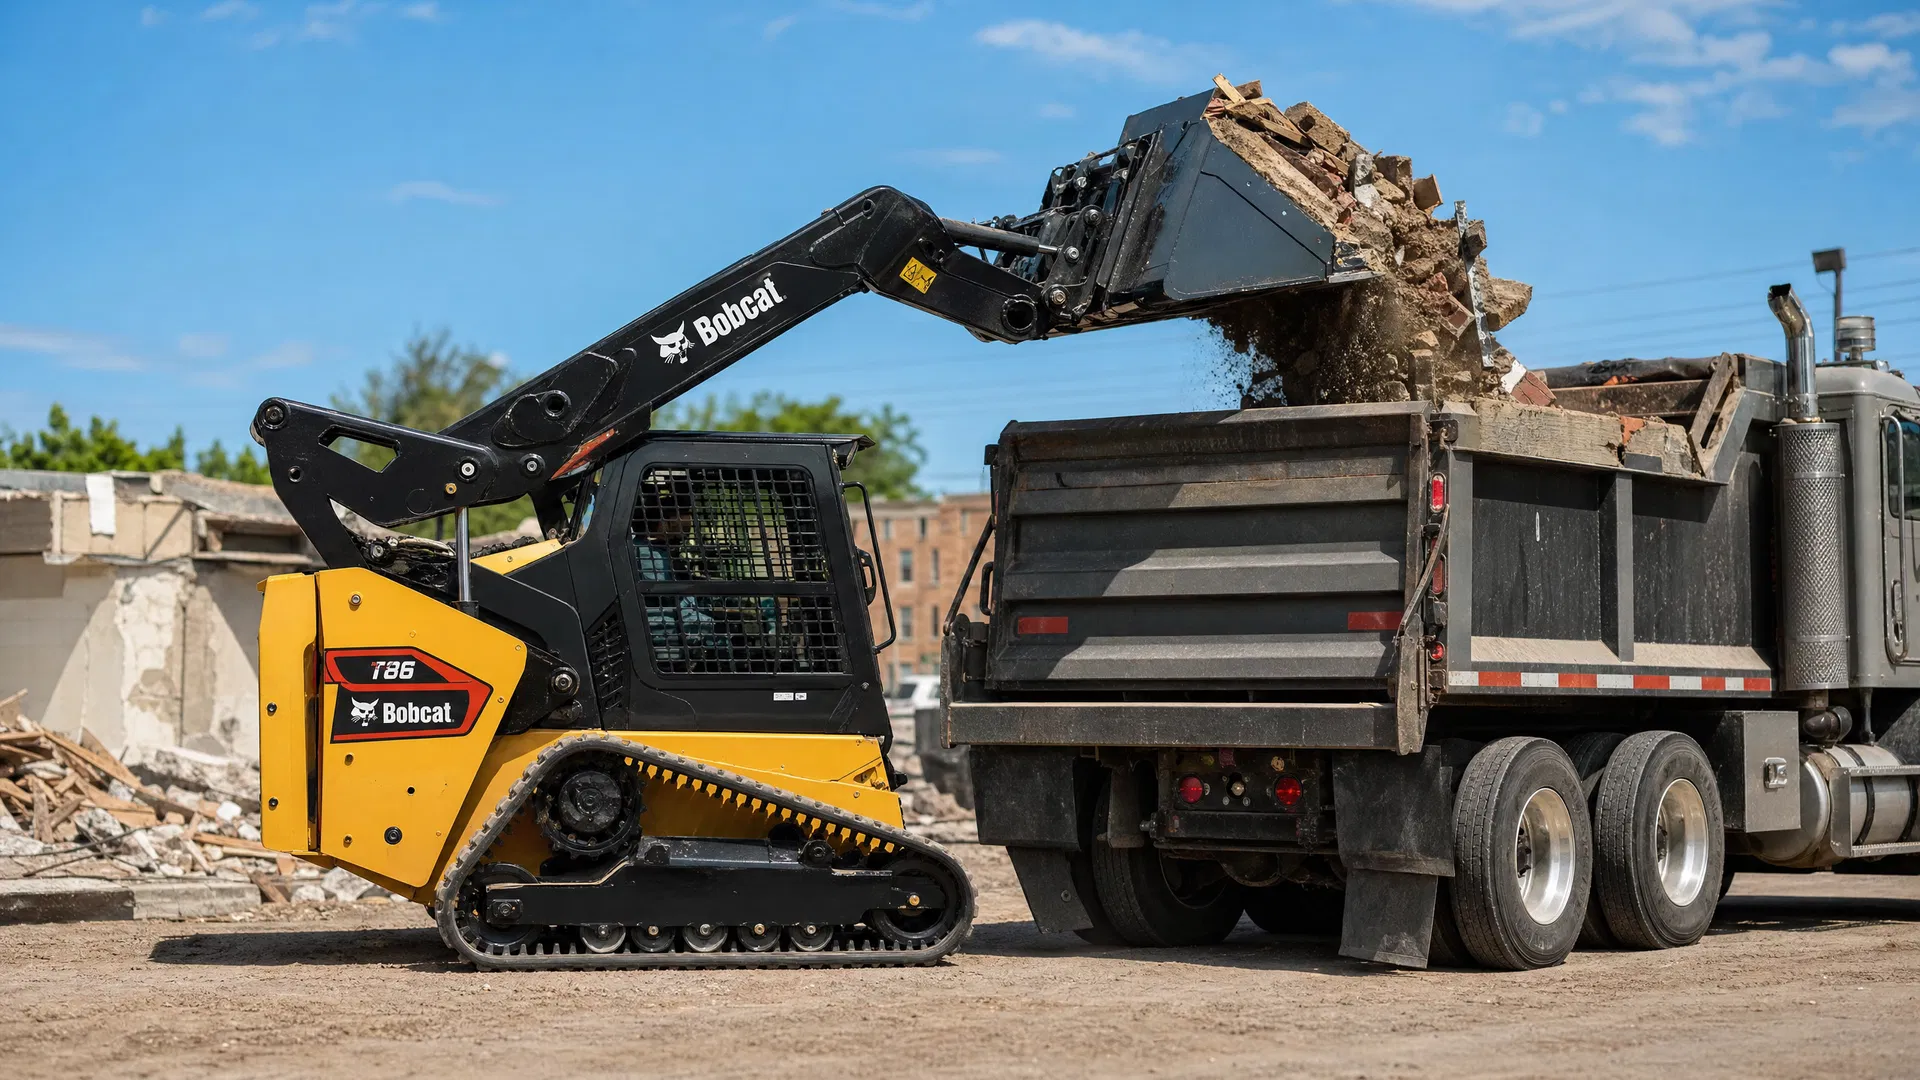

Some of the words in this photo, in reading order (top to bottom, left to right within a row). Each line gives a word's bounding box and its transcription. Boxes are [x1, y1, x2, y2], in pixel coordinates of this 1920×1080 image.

[693, 277, 784, 347] Bobcat
[371, 661, 416, 680] T86
[383, 702, 452, 724] Bobcat
